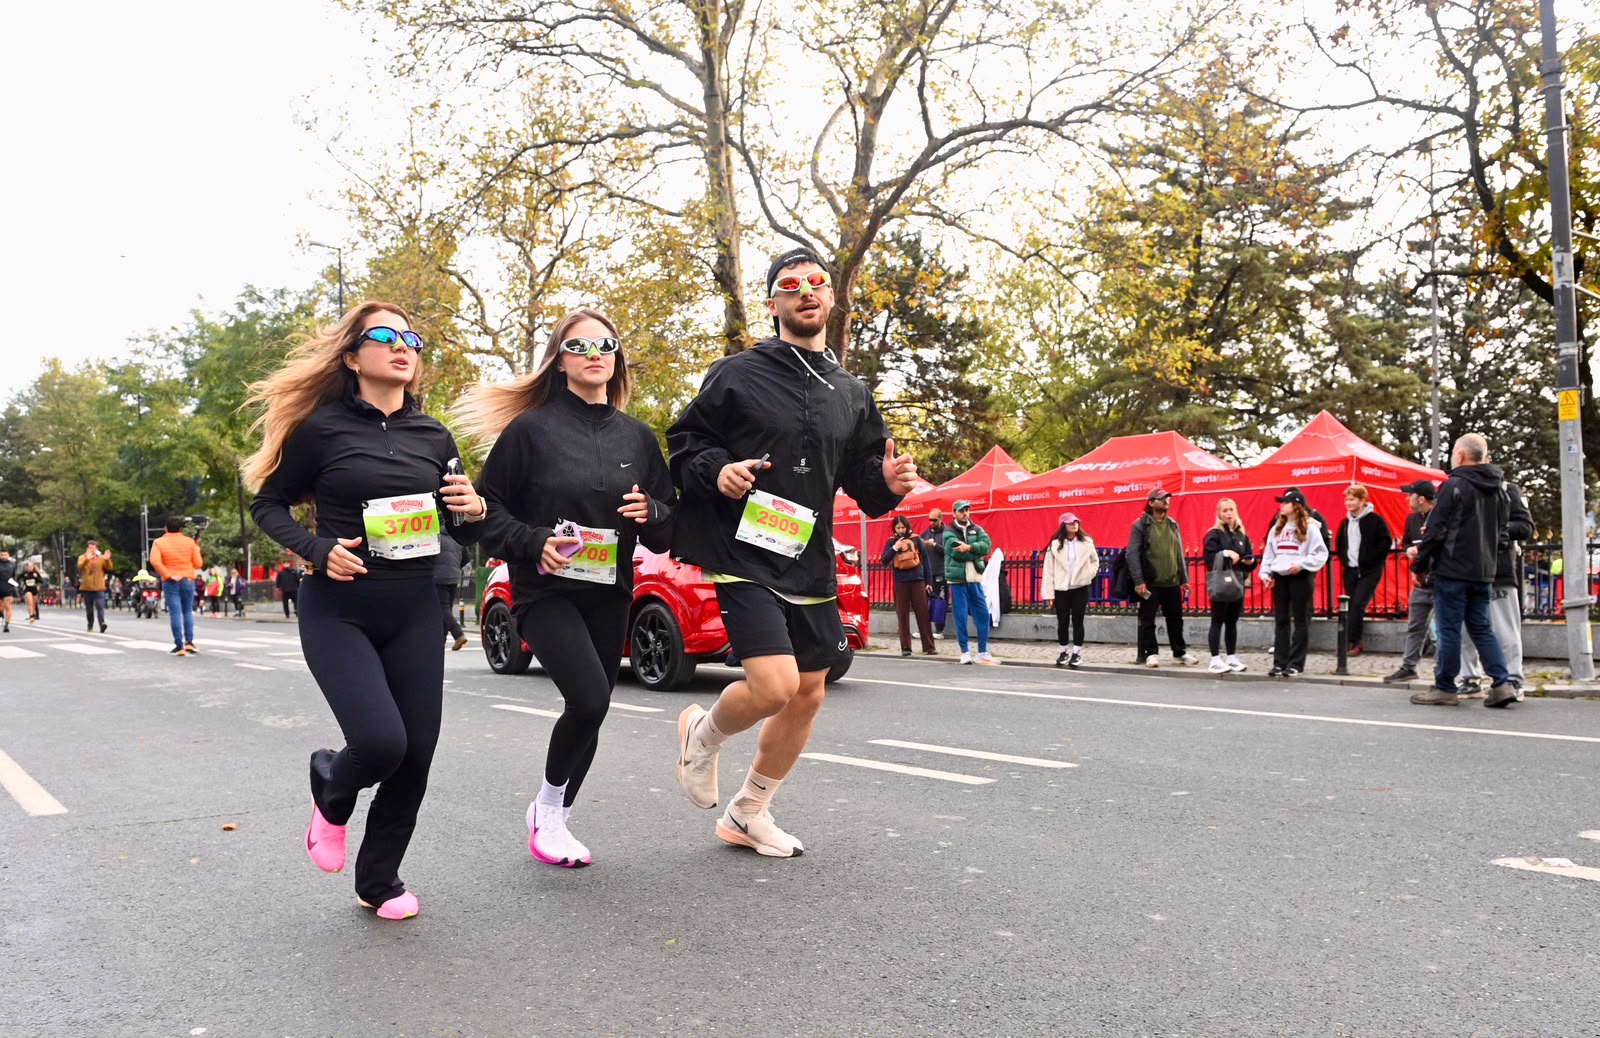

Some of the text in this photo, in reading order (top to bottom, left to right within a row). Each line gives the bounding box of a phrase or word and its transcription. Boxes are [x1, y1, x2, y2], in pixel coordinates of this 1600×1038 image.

[1061, 455, 1171, 473] sportstouch
[1291, 463, 1345, 478] sportstouch
[1192, 472, 1239, 484] sportstouch
[1360, 465, 1397, 480] sportstouch
[1058, 485, 1105, 499] sportstouch
[1113, 480, 1163, 495] sportstouch
[1007, 490, 1050, 503] sportstouch
[384, 515, 433, 535] 3707
[756, 511, 800, 536] 2909
[577, 545, 609, 562] 708
